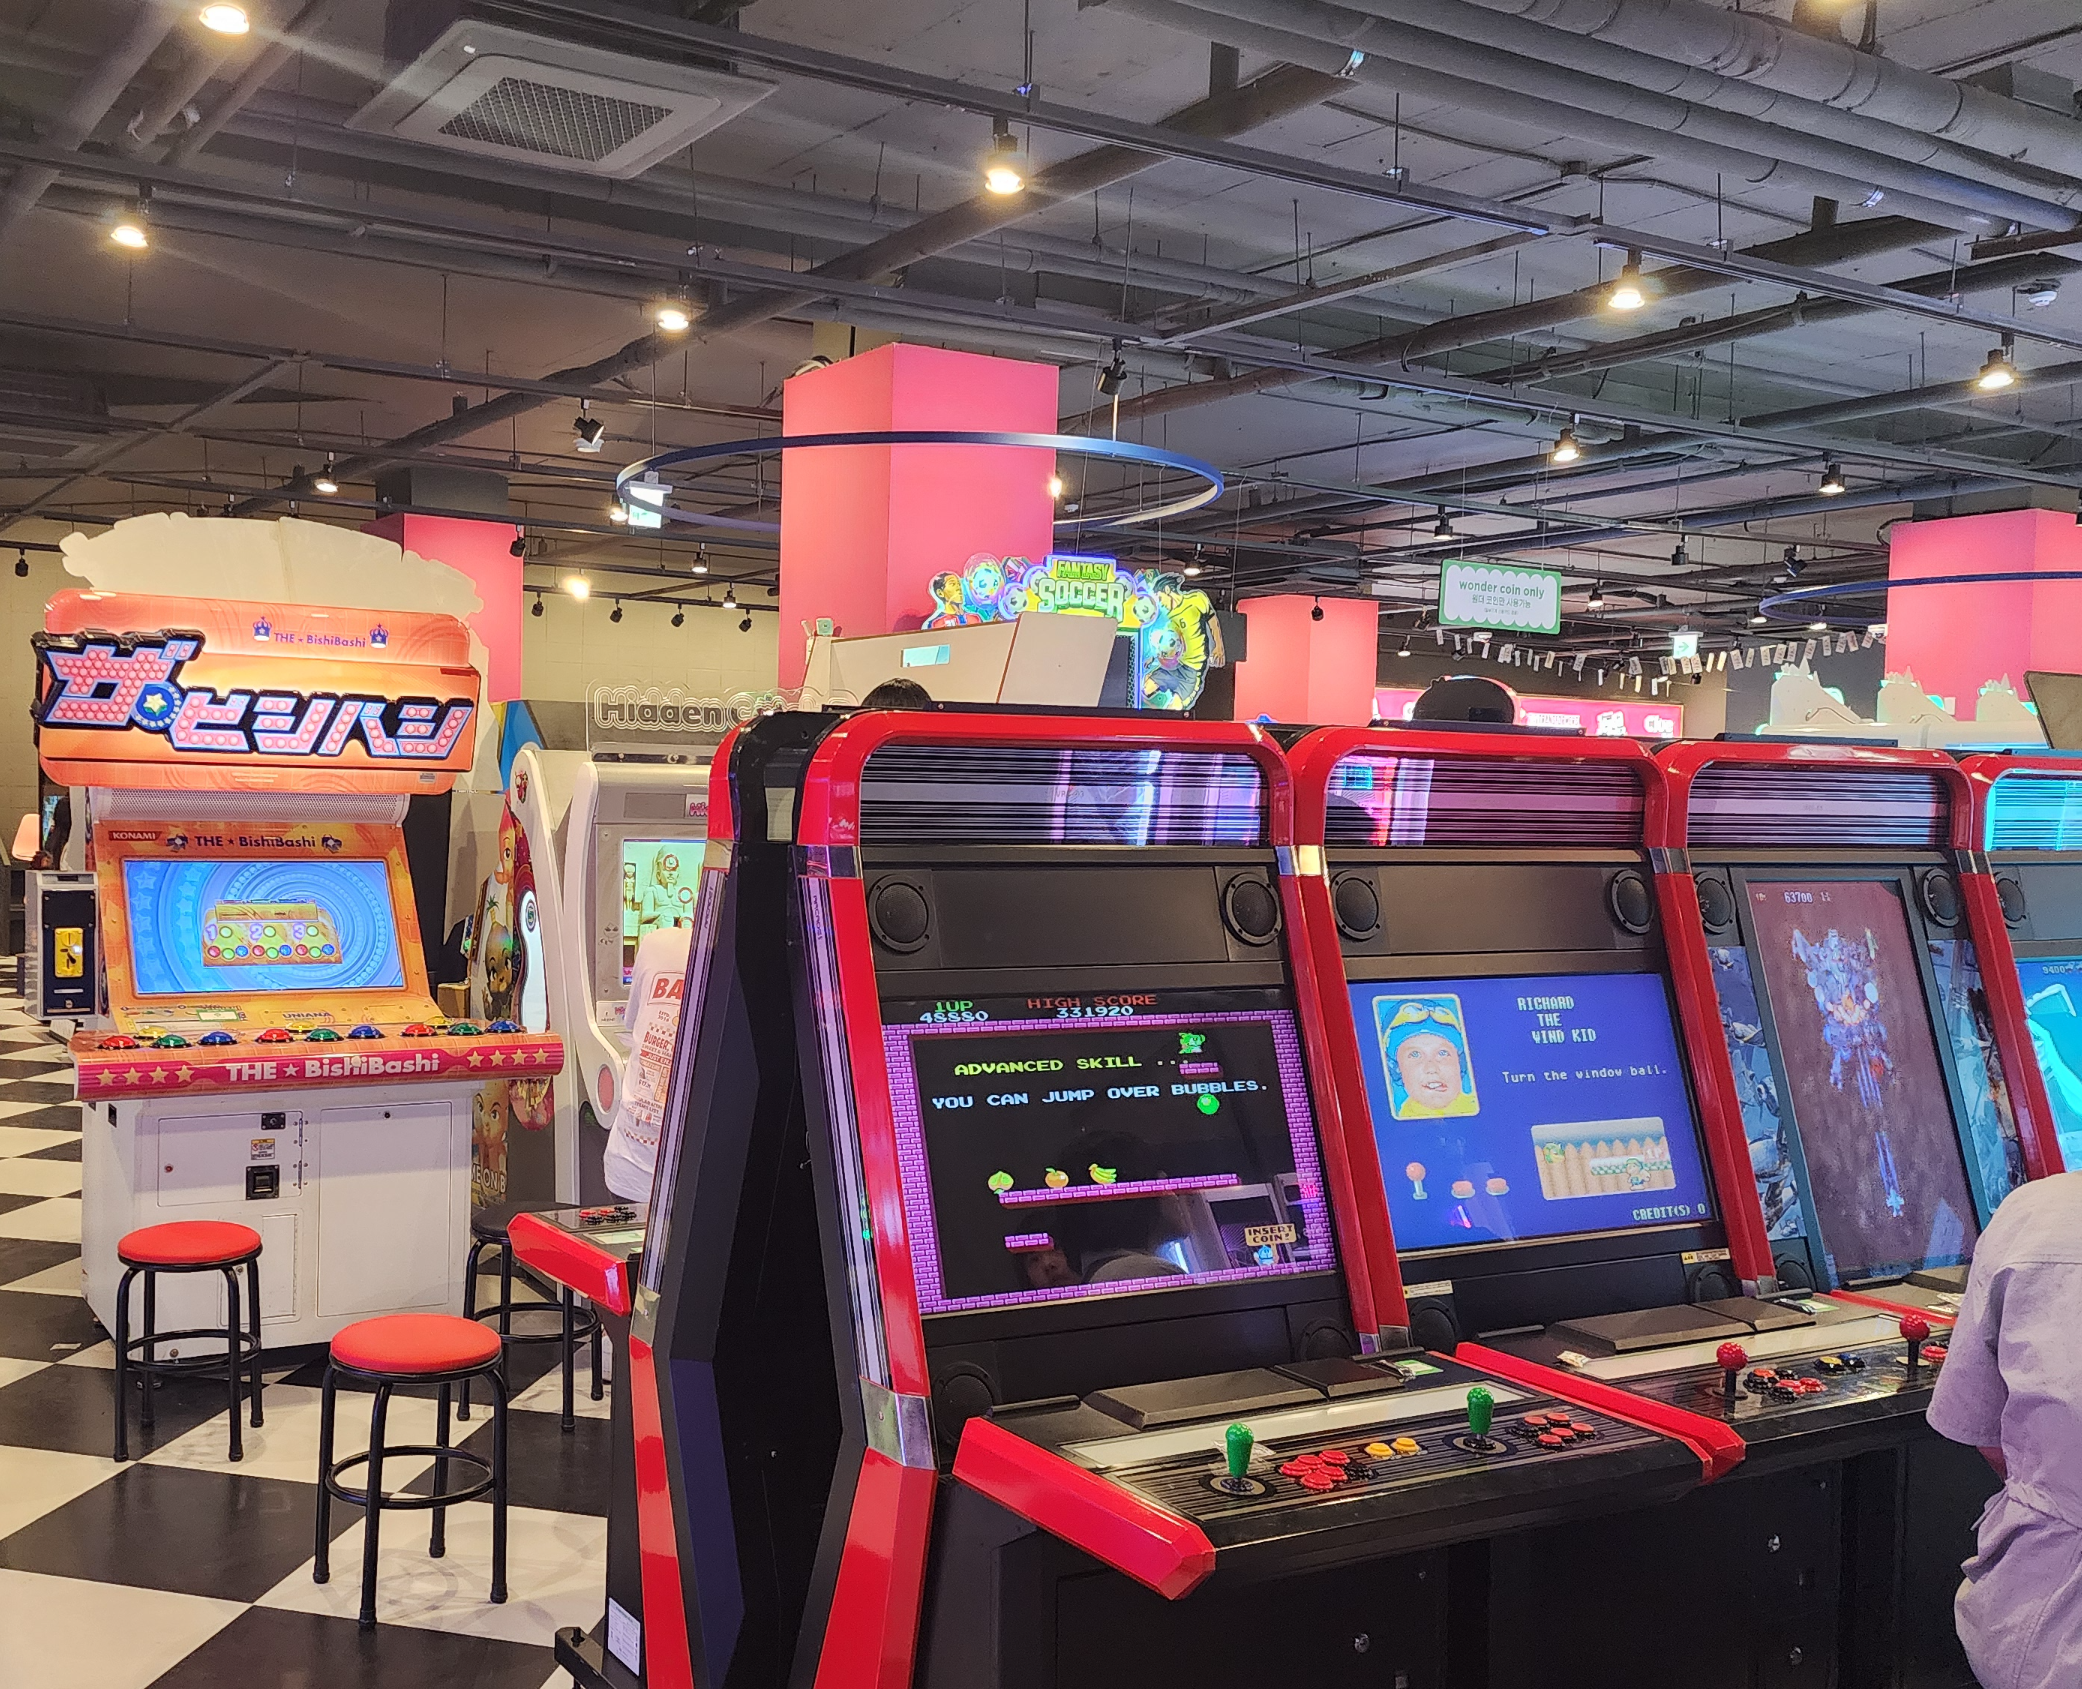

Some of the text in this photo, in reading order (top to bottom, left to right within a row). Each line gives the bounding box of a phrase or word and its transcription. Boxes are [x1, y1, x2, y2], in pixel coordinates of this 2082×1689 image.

[1057, 560, 1110, 581] FANTASY
[1459, 580, 1545, 600] wonder coin only
[1038, 578, 1124, 622] SOCCER
[1472, 594, 1531, 609] 원더 코인만 사용가능
[274, 632, 366, 648] THE BishiBashi
[111, 831, 156, 841] KONAMI
[194, 834, 317, 848] THE BishiBashi
[1784, 891, 1813, 903] 63700
[250, 923, 263, 942] 2
[293, 922, 306, 940] 3
[935, 1000, 973, 1013] 1UP
[1027, 994, 1158, 1009] HIGH SCORE
[1517, 995, 1575, 1011] RICHARD
[919, 1010, 989, 1023] 48880
[1056, 1005, 1134, 1018] 331920
[1536, 1013, 1562, 1027] THE
[1531, 1028, 1597, 1044] WIND KID
[226, 1053, 440, 1082] THE BishiBashi
[954, 1059, 1064, 1076] ADVANCED
[1076, 1056, 1143, 1070] SKILL
[1502, 1064, 1667, 1084] Turn the window ball.
[932, 1080, 1267, 1110] YOU CAN JUMP OVER BUBBLES.
[1632, 1203, 1706, 1221] CREDIT(S) 0
[1248, 1225, 1293, 1236] INSERT
